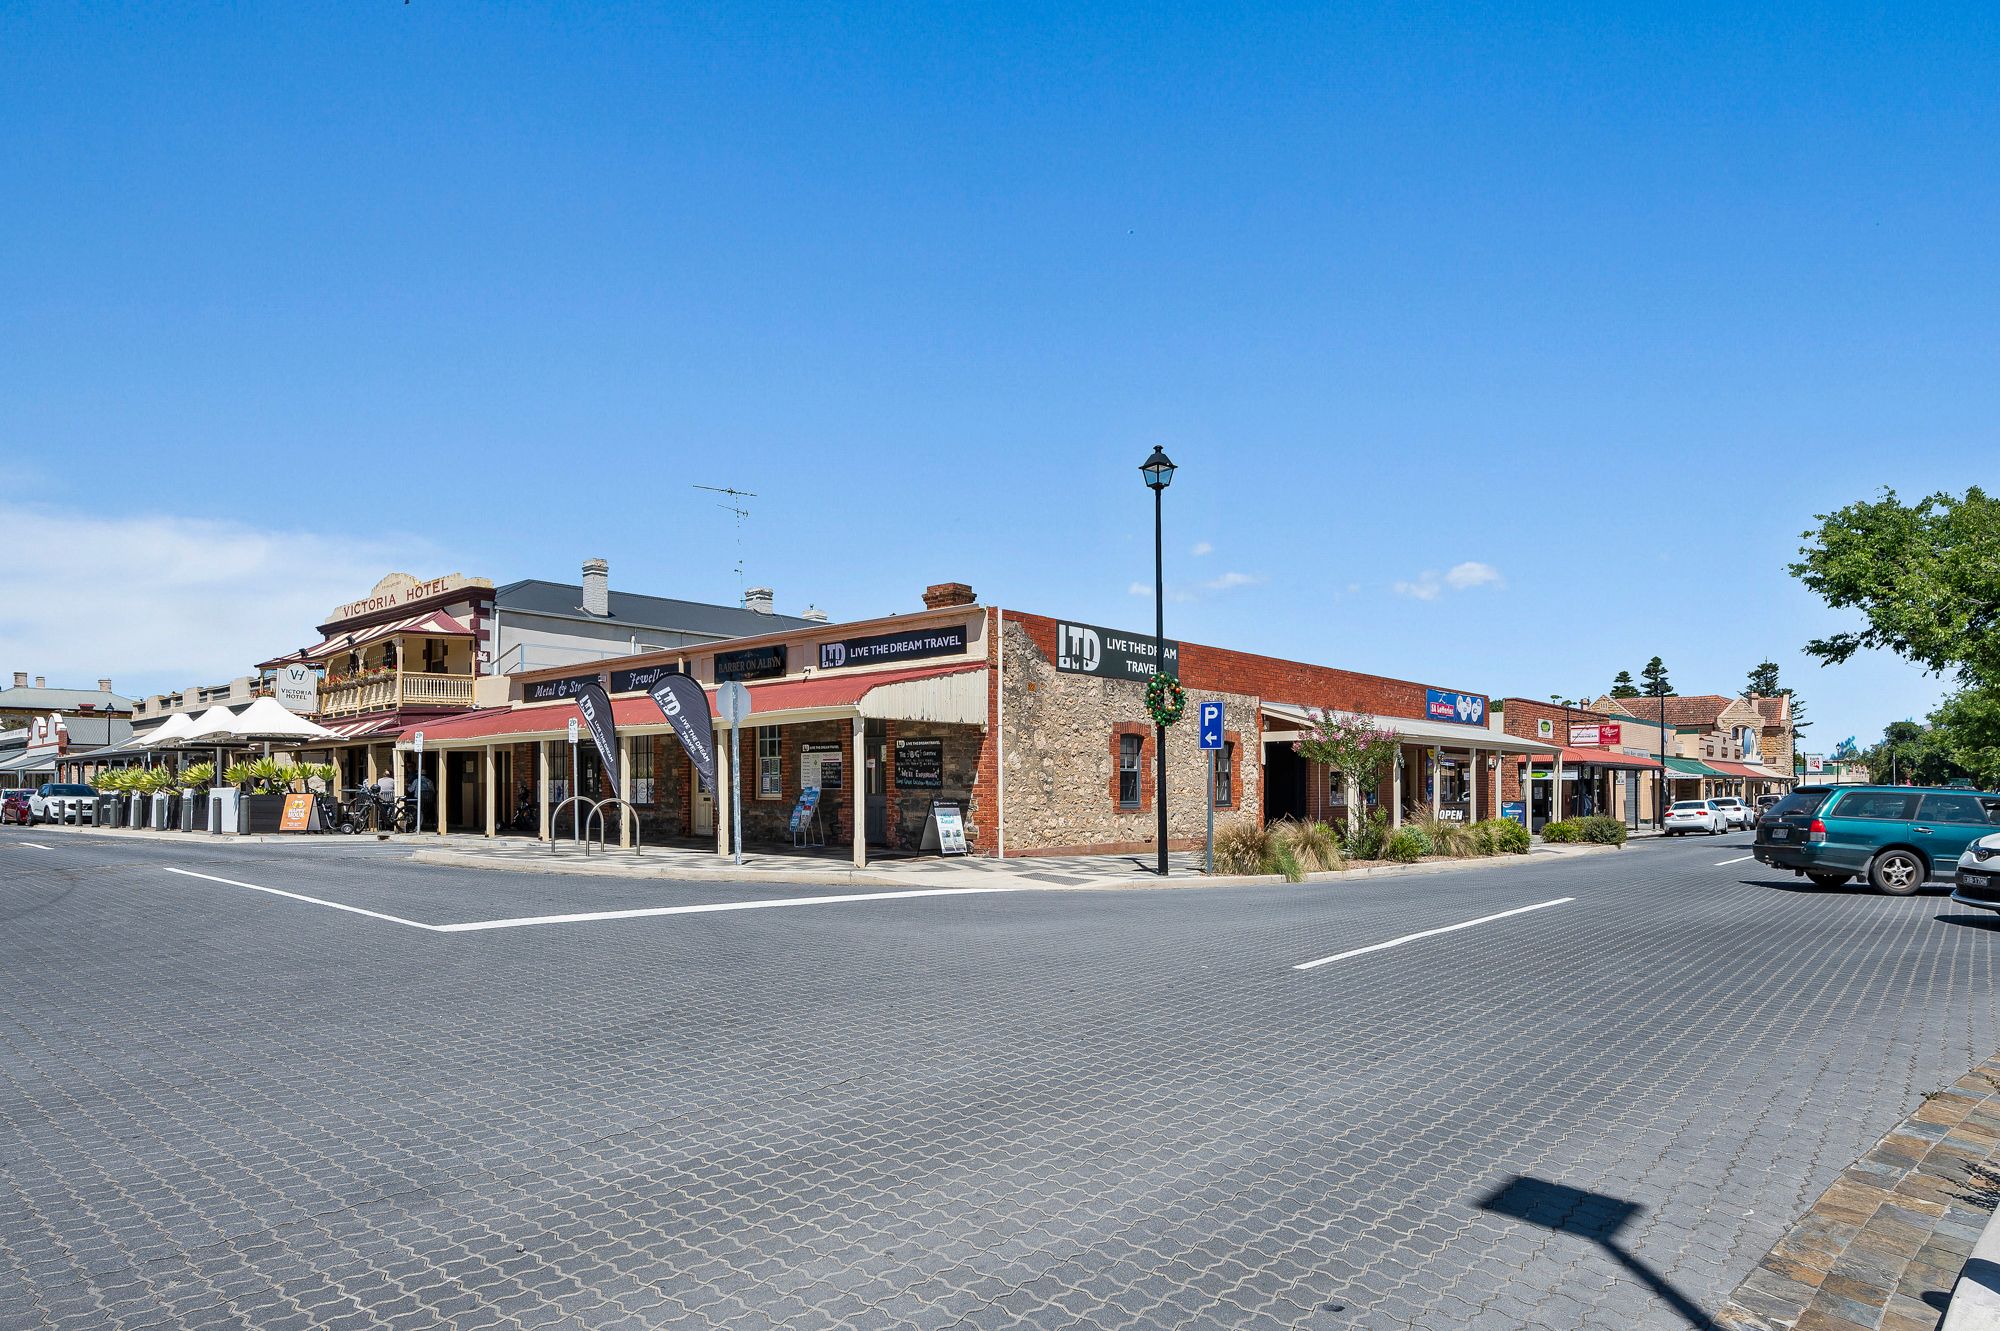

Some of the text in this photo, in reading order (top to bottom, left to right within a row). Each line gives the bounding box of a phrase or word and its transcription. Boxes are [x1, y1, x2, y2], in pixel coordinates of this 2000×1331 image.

[343, 594, 397, 618] VICTORIA
[406, 579, 449, 602] HOTEL
[850, 646, 869, 658] LIVE
[870, 644, 889, 655] THE
[890, 639, 923, 653] DREAM
[924, 635, 962, 650] TRAVEL
[1106, 637, 1127, 653] LIVE
[1128, 641, 1147, 657] THE
[1147, 644, 1177, 660] DRAM
[718, 656, 781, 673] BARBER ON ALBYN
[281, 688, 312, 696] VICTORIA
[534, 683, 557, 698] Metal
[1204, 706, 1219, 727] P
[680, 715, 711, 763] LIVE THE DREAM
[681, 730, 697, 755] TRAVEL
[603, 742, 614, 763] DREAM
[1438, 809, 1464, 820] OPEN
